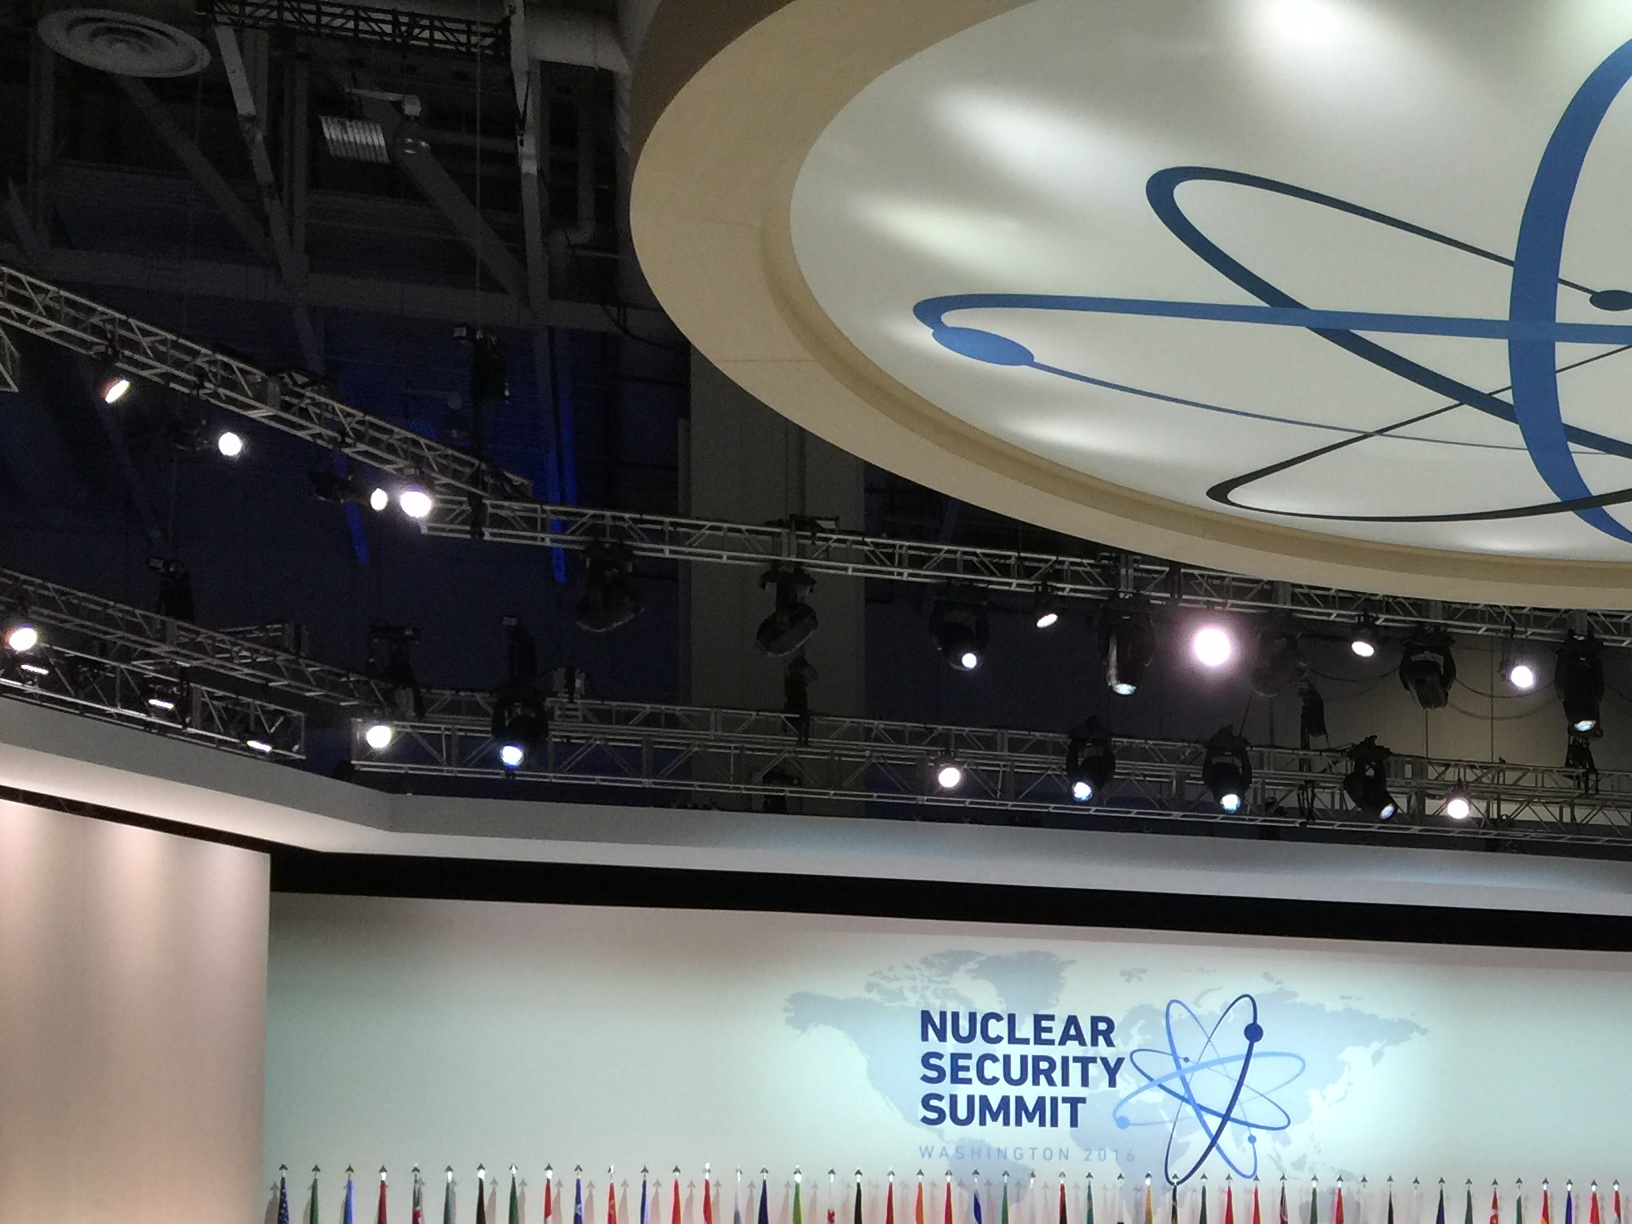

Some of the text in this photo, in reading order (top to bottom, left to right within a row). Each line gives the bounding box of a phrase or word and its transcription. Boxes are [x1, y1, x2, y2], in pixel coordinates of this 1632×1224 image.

[920, 1009, 1116, 1048] NUCLEAR
[919, 1050, 1126, 1089] SECURITY
[919, 1092, 1087, 1129] SUMMIT
[918, 1145, 1136, 1163] WASHINGTON 2016
